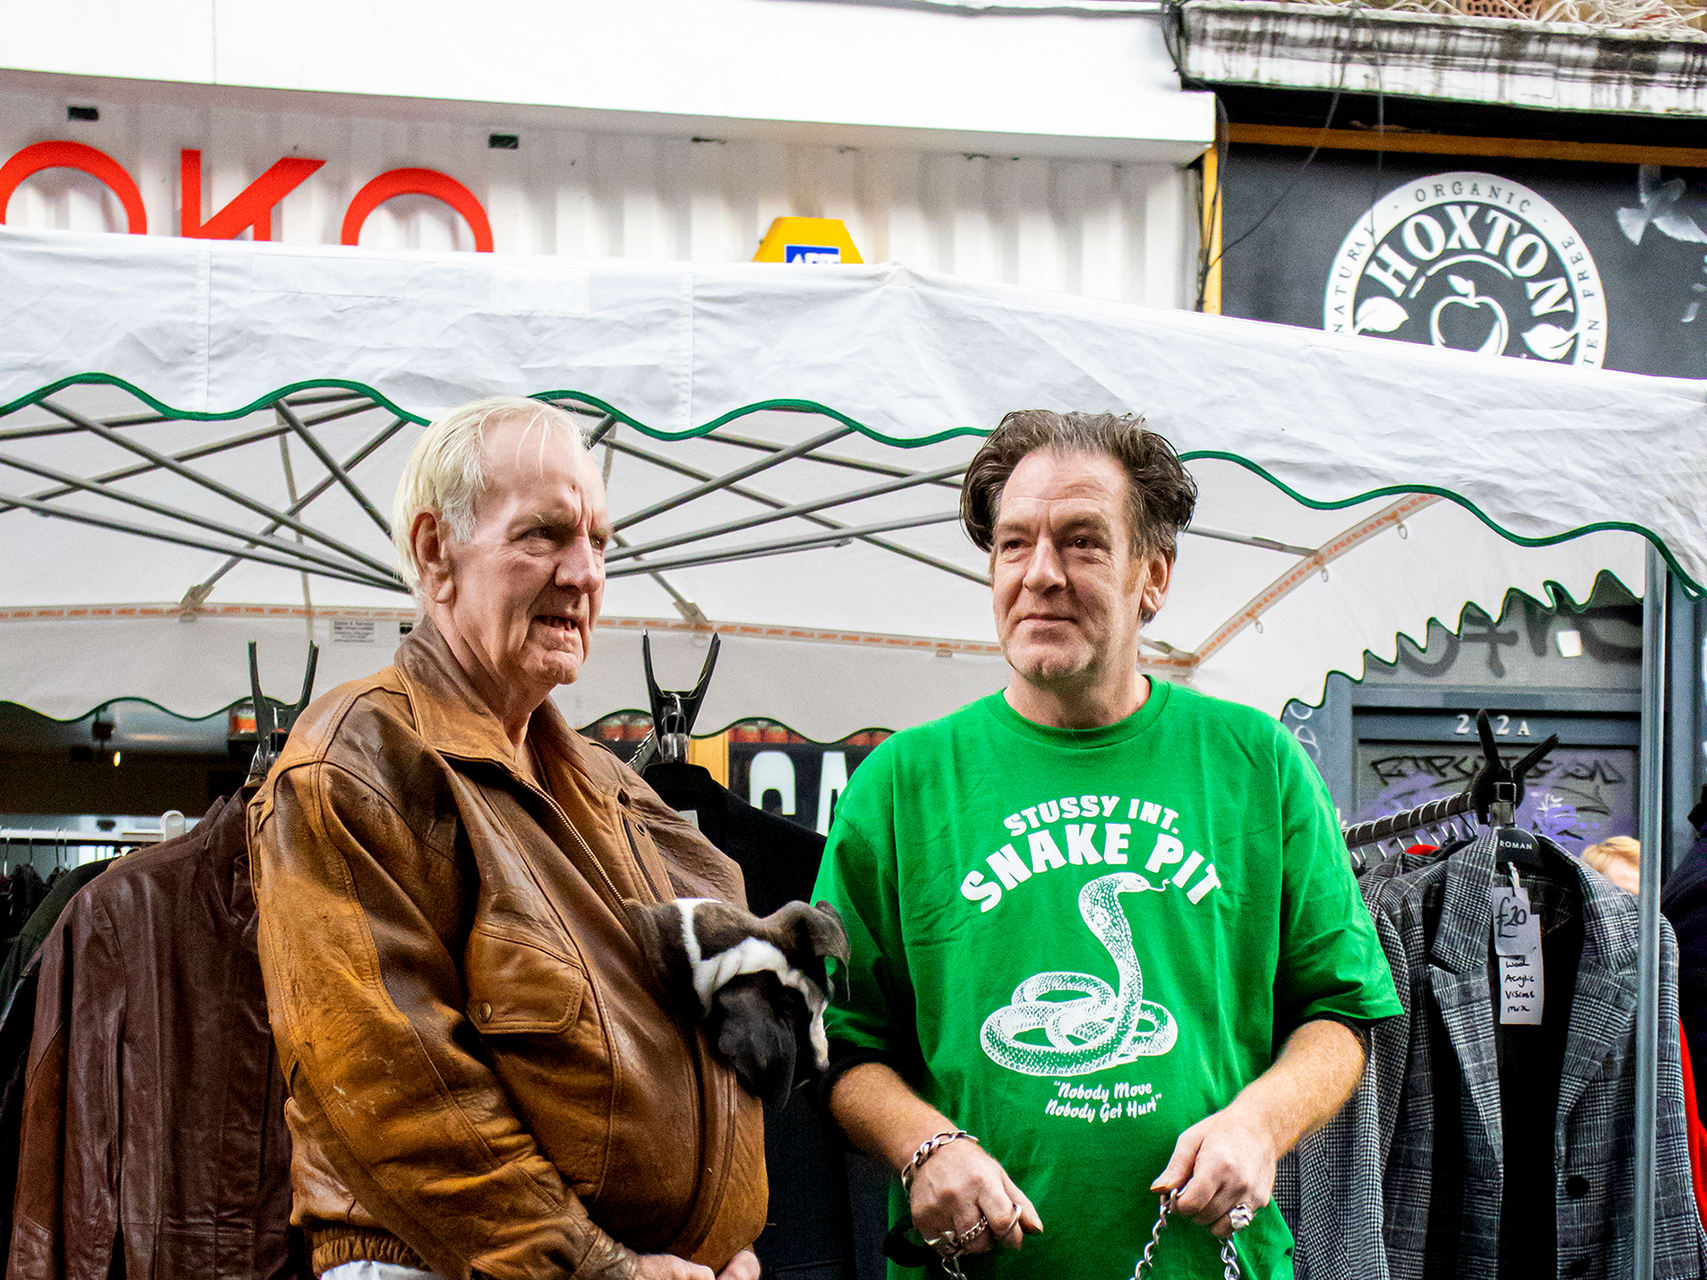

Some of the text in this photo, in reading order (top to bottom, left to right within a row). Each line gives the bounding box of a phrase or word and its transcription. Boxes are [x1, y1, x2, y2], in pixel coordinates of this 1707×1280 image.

[1416, 181, 1531, 213] ORGANIC
[1364, 204, 1575, 317] HOXTON
[1561, 235, 1598, 299] FREE
[1454, 714, 1531, 737] 22A
[1003, 795, 1179, 836] STUSSY INT.
[1499, 840, 1533, 850] ROMAN
[960, 823, 1221, 913] SNAKE PIT
[1495, 896, 1527, 938] £20
[1113, 1082, 1153, 1099] Move
[1044, 1098, 1096, 1123] Nobody
[1099, 1102, 1123, 1123] Get
